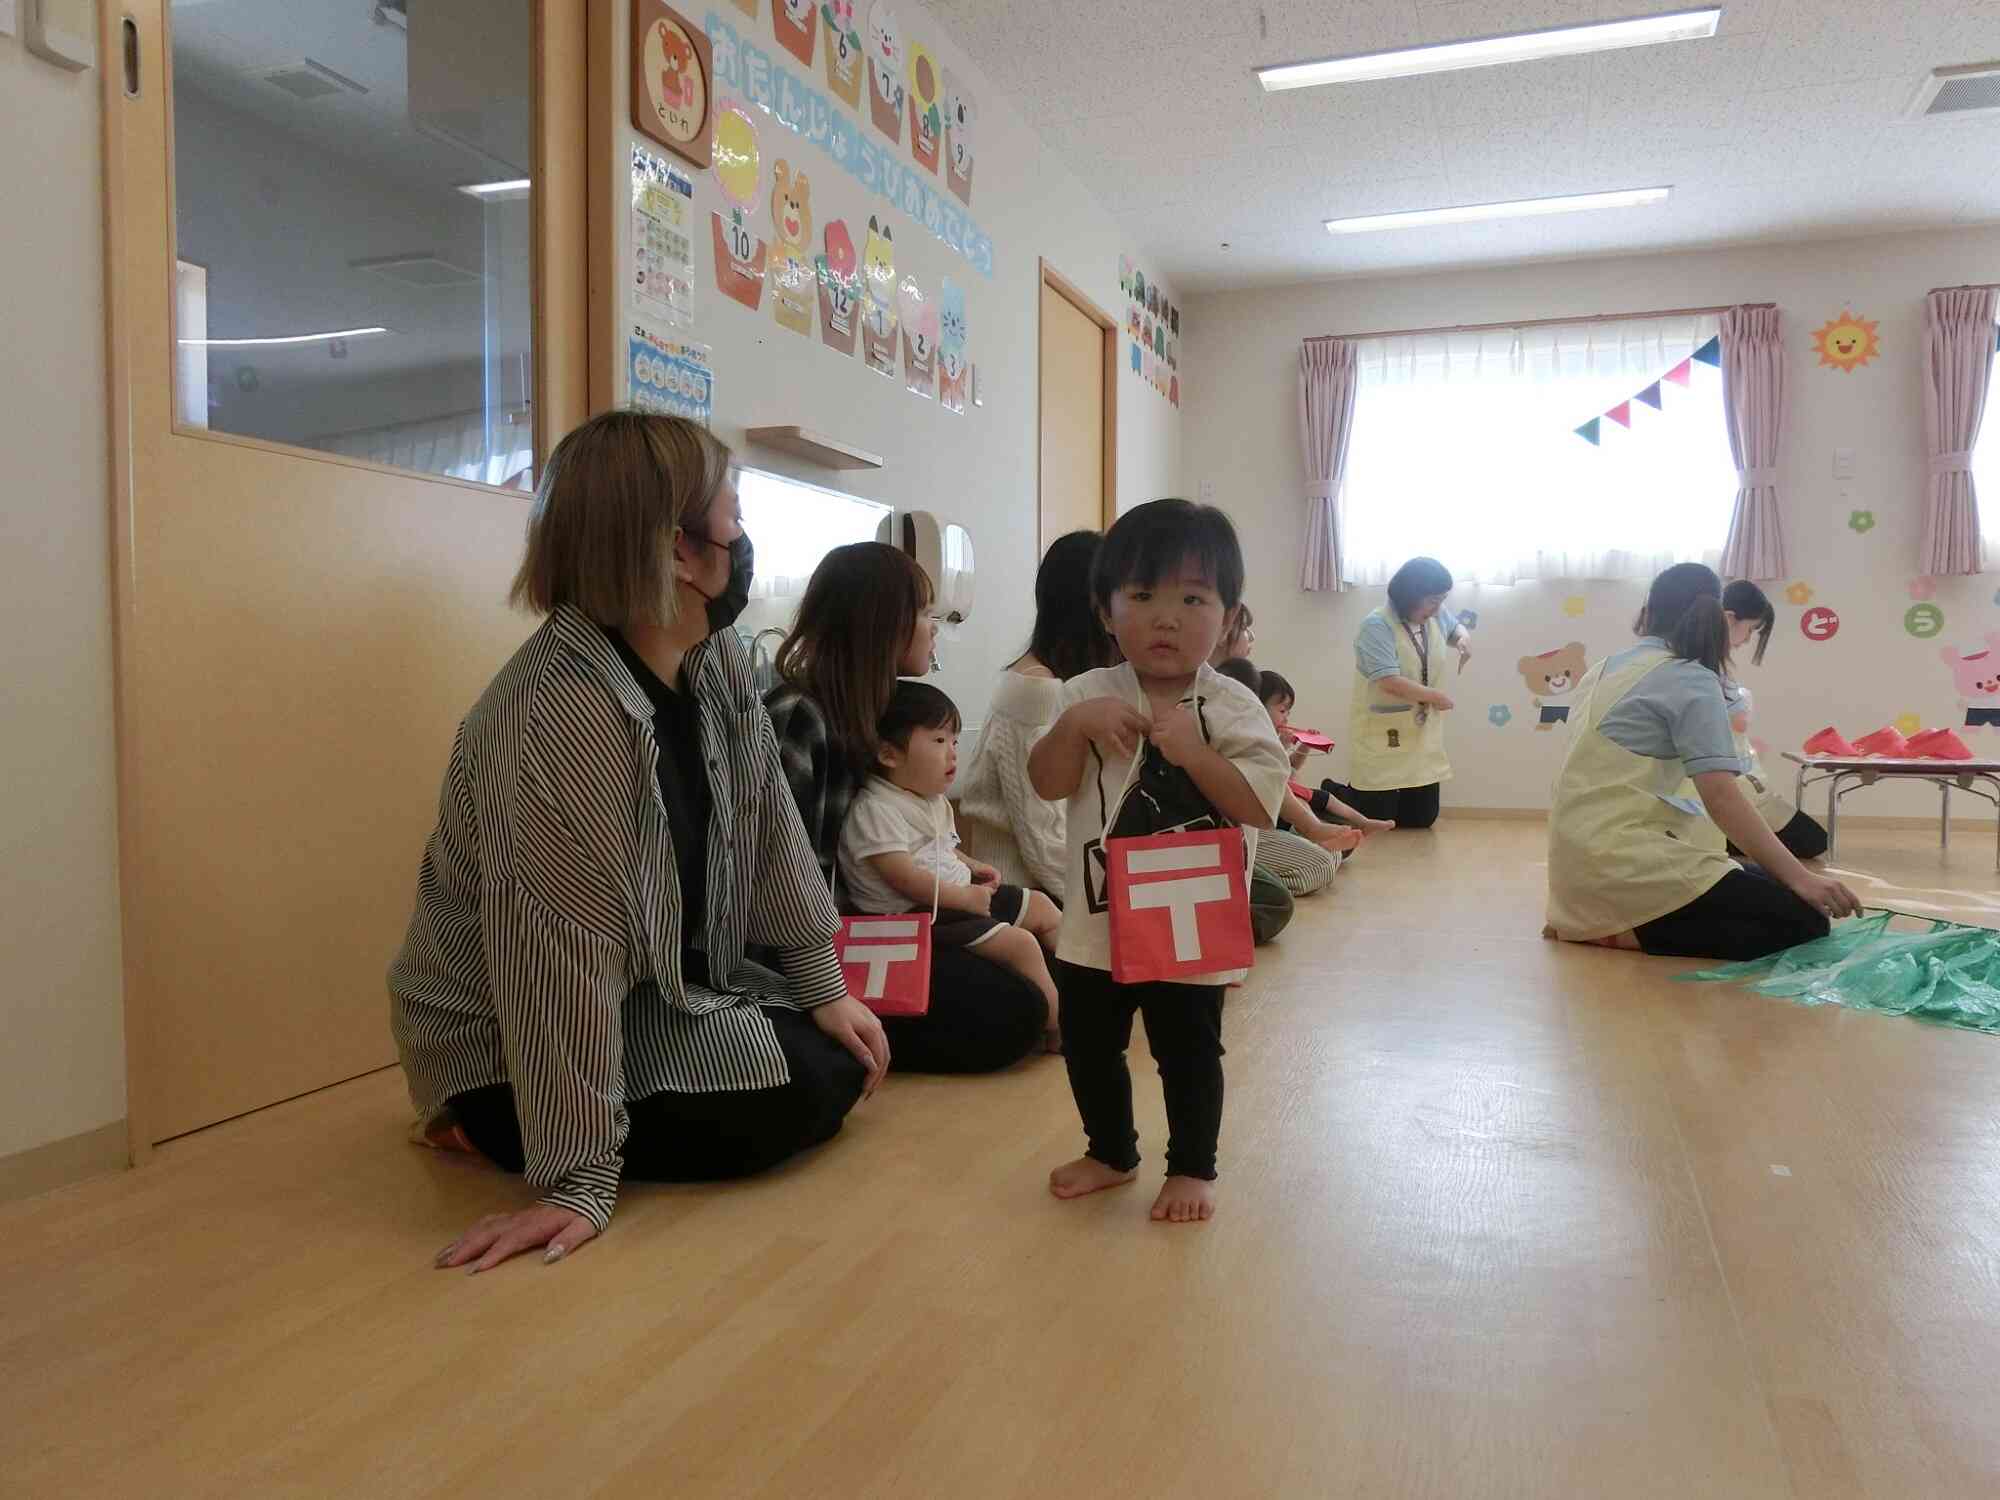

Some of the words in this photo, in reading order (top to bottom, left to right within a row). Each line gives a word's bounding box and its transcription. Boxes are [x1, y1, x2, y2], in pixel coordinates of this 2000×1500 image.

[839, 31, 848, 59] 6
[881, 72, 890, 98] 7
[922, 114, 930, 139] 8
[957, 143, 964, 164] 9
[731, 225, 750, 260] 10
[833, 286, 849, 314] 12
[917, 333, 926, 355] 2
